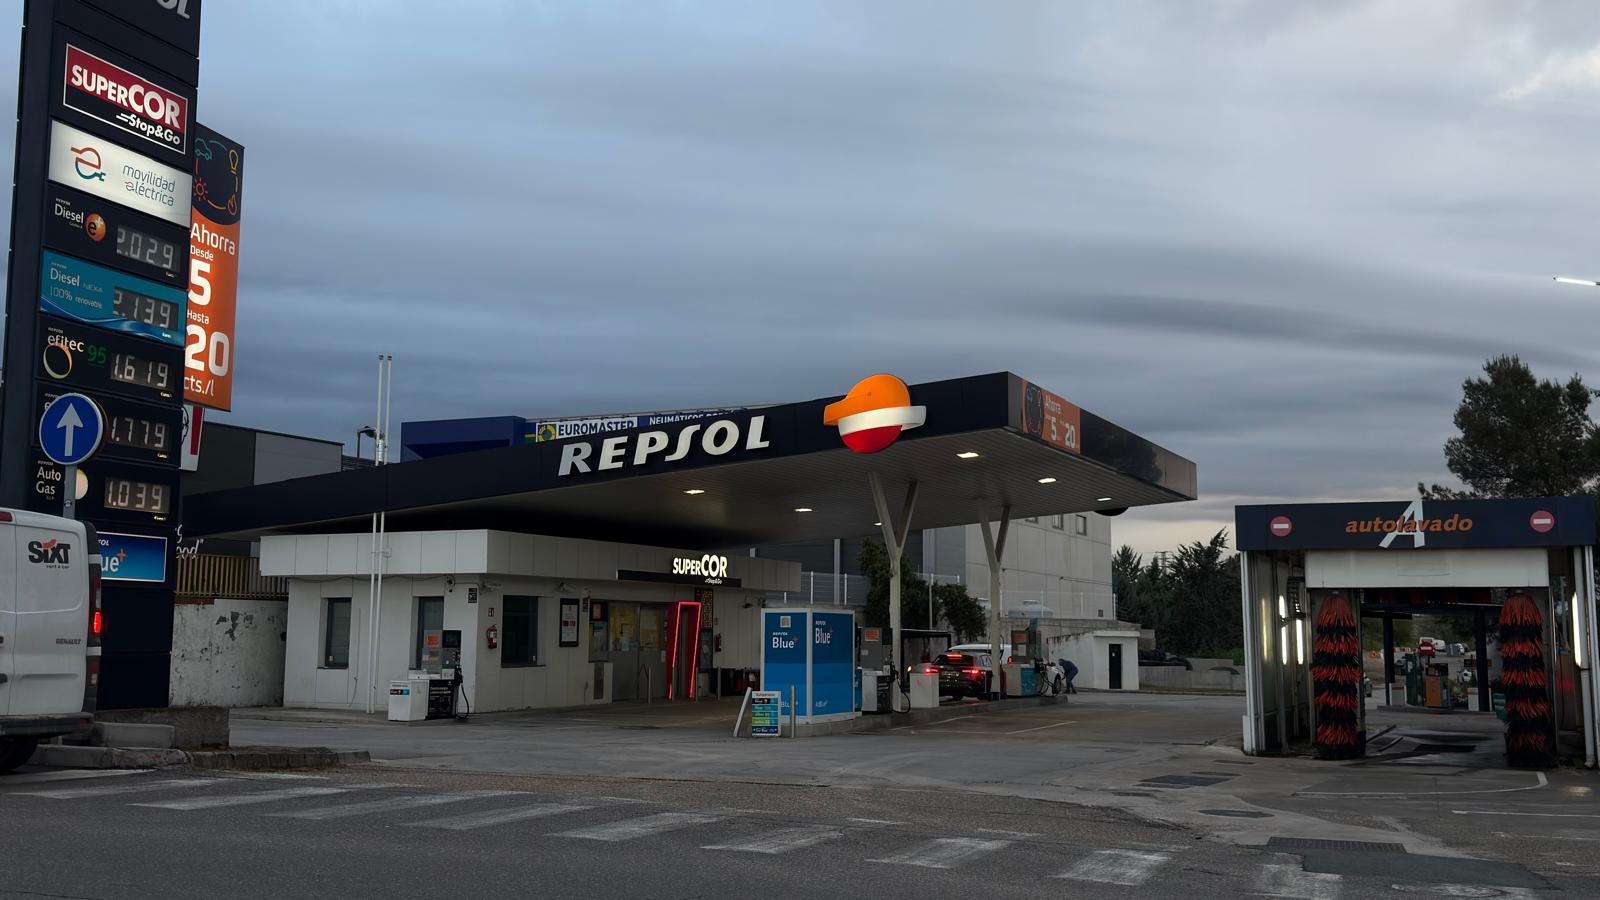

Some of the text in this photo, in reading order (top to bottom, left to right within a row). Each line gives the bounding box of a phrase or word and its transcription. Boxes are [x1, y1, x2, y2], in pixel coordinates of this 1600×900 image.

[71, 64, 181, 128] SUPERCOR
[128, 113, 181, 145] Stop&Go
[123, 165, 176, 193] movilidad
[124, 181, 175, 207] eléctrica
[54, 203, 84, 224] Diesel
[116, 228, 174, 269] 2.029
[190, 222, 236, 256] Ahorra
[190, 245, 214, 261] Desde
[50, 267, 80, 287] Diesel
[188, 258, 212, 306] 5
[50, 285, 73, 301] 100%
[113, 288, 171, 329] 2.139
[187, 309, 210, 325] Hasta
[47, 334, 107, 364] efitec 95
[185, 324, 230, 377] 20
[114, 353, 169, 388] 1.619
[111, 416, 165, 449] 1.779
[1051, 416, 1057, 441] 5
[1065, 422, 1076, 449] 20
[558, 415, 770, 477] REPSOL
[36, 466, 61, 482] Auto
[36, 481, 56, 495] Gas
[107, 480, 162, 510] 1.039
[1345, 513, 1473, 534] autolavado
[672, 554, 728, 578] SUPERCOR
